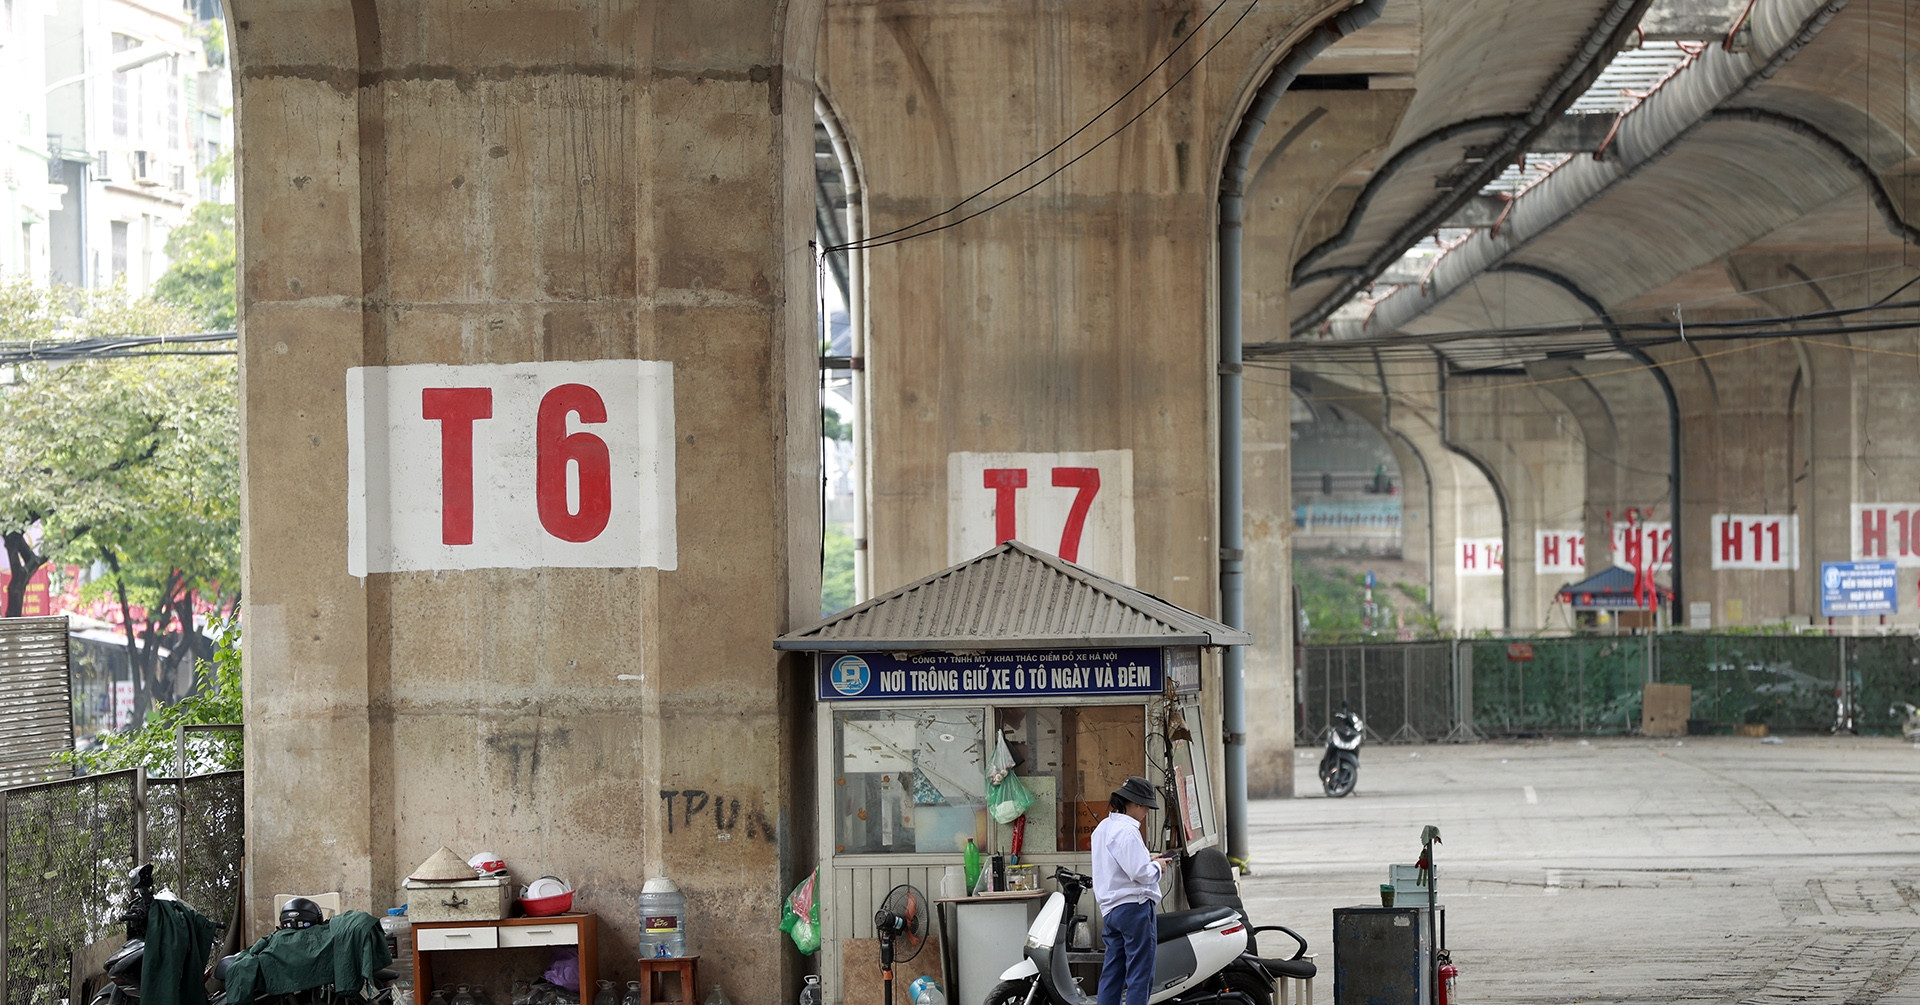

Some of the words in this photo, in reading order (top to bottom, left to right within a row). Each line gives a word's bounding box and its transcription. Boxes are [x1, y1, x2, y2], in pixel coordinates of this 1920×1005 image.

[422, 387, 493, 546] T
[536, 383, 612, 544] 6
[983, 468, 1028, 547] T
[1051, 467, 1101, 564] 7
[1721, 521, 1780, 563] H11
[880, 669, 906, 692] NƠI
[910, 666, 959, 691] TRÔNG
[963, 664, 990, 691] GIỮ
[991, 669, 1011, 690] XE
[1015, 664, 1025, 690] Ô
[1029, 664, 1047, 690] TÔ
[1051, 663, 1091, 689] NGÀY
[1094, 662, 1114, 688] VÀ
[1118, 662, 1151, 688] ĐÊM
[912, 655, 936, 664] CÔNG
[974, 655, 992, 663] MTV
[994, 655, 1014, 663] KHAI
[1016, 653, 1038, 662] THÁC
[1076, 653, 1087, 661] XE
[1103, 651, 1118, 662] NỘI
